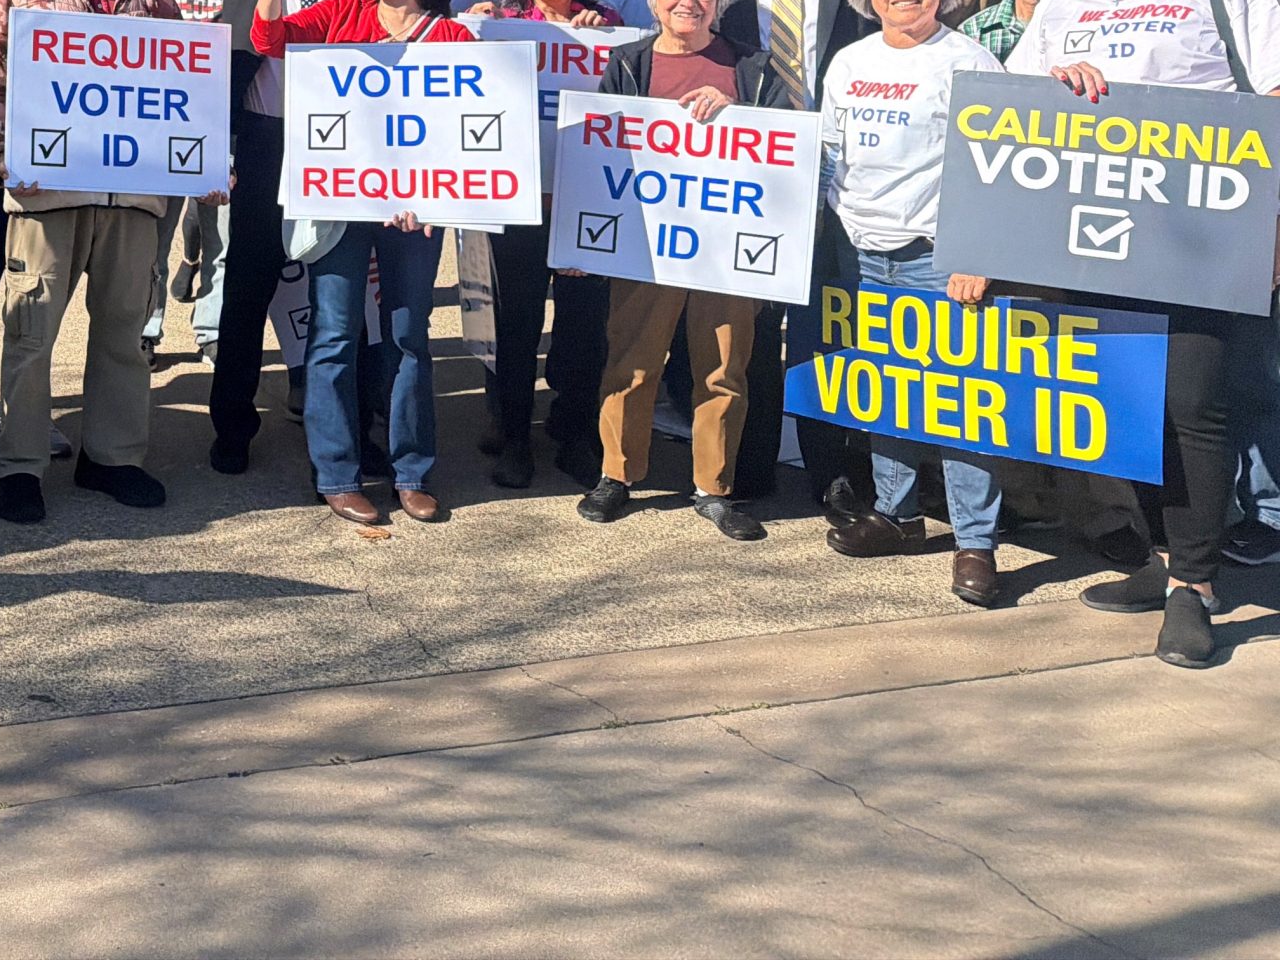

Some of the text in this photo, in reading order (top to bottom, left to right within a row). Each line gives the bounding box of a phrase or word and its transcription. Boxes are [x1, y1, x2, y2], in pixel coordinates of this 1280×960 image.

[1078, 4, 1194, 23] WE SUPPORT
[1100, 21, 1176, 36] VOTER
[31, 29, 211, 74] REQUIRE
[1108, 43, 1135, 58] ID
[328, 65, 485, 97] VOTER
[846, 80, 919, 100] SUPPORT
[51, 81, 190, 122] VOTER
[852, 107, 910, 126] VOTER
[385, 114, 426, 147] ID
[583, 113, 796, 167] REQUIRE
[858, 132, 880, 147] ID
[957, 104, 1272, 169] CALIFORNIA
[103, 134, 139, 168] ID
[303, 167, 519, 200] REQUIRED
[603, 165, 764, 218] VOTER
[968, 141, 1250, 211] VOTER ID
[656, 223, 699, 260] ID
[822, 285, 1099, 386] REQUIRE
[813, 352, 1107, 461] VOTER ID
